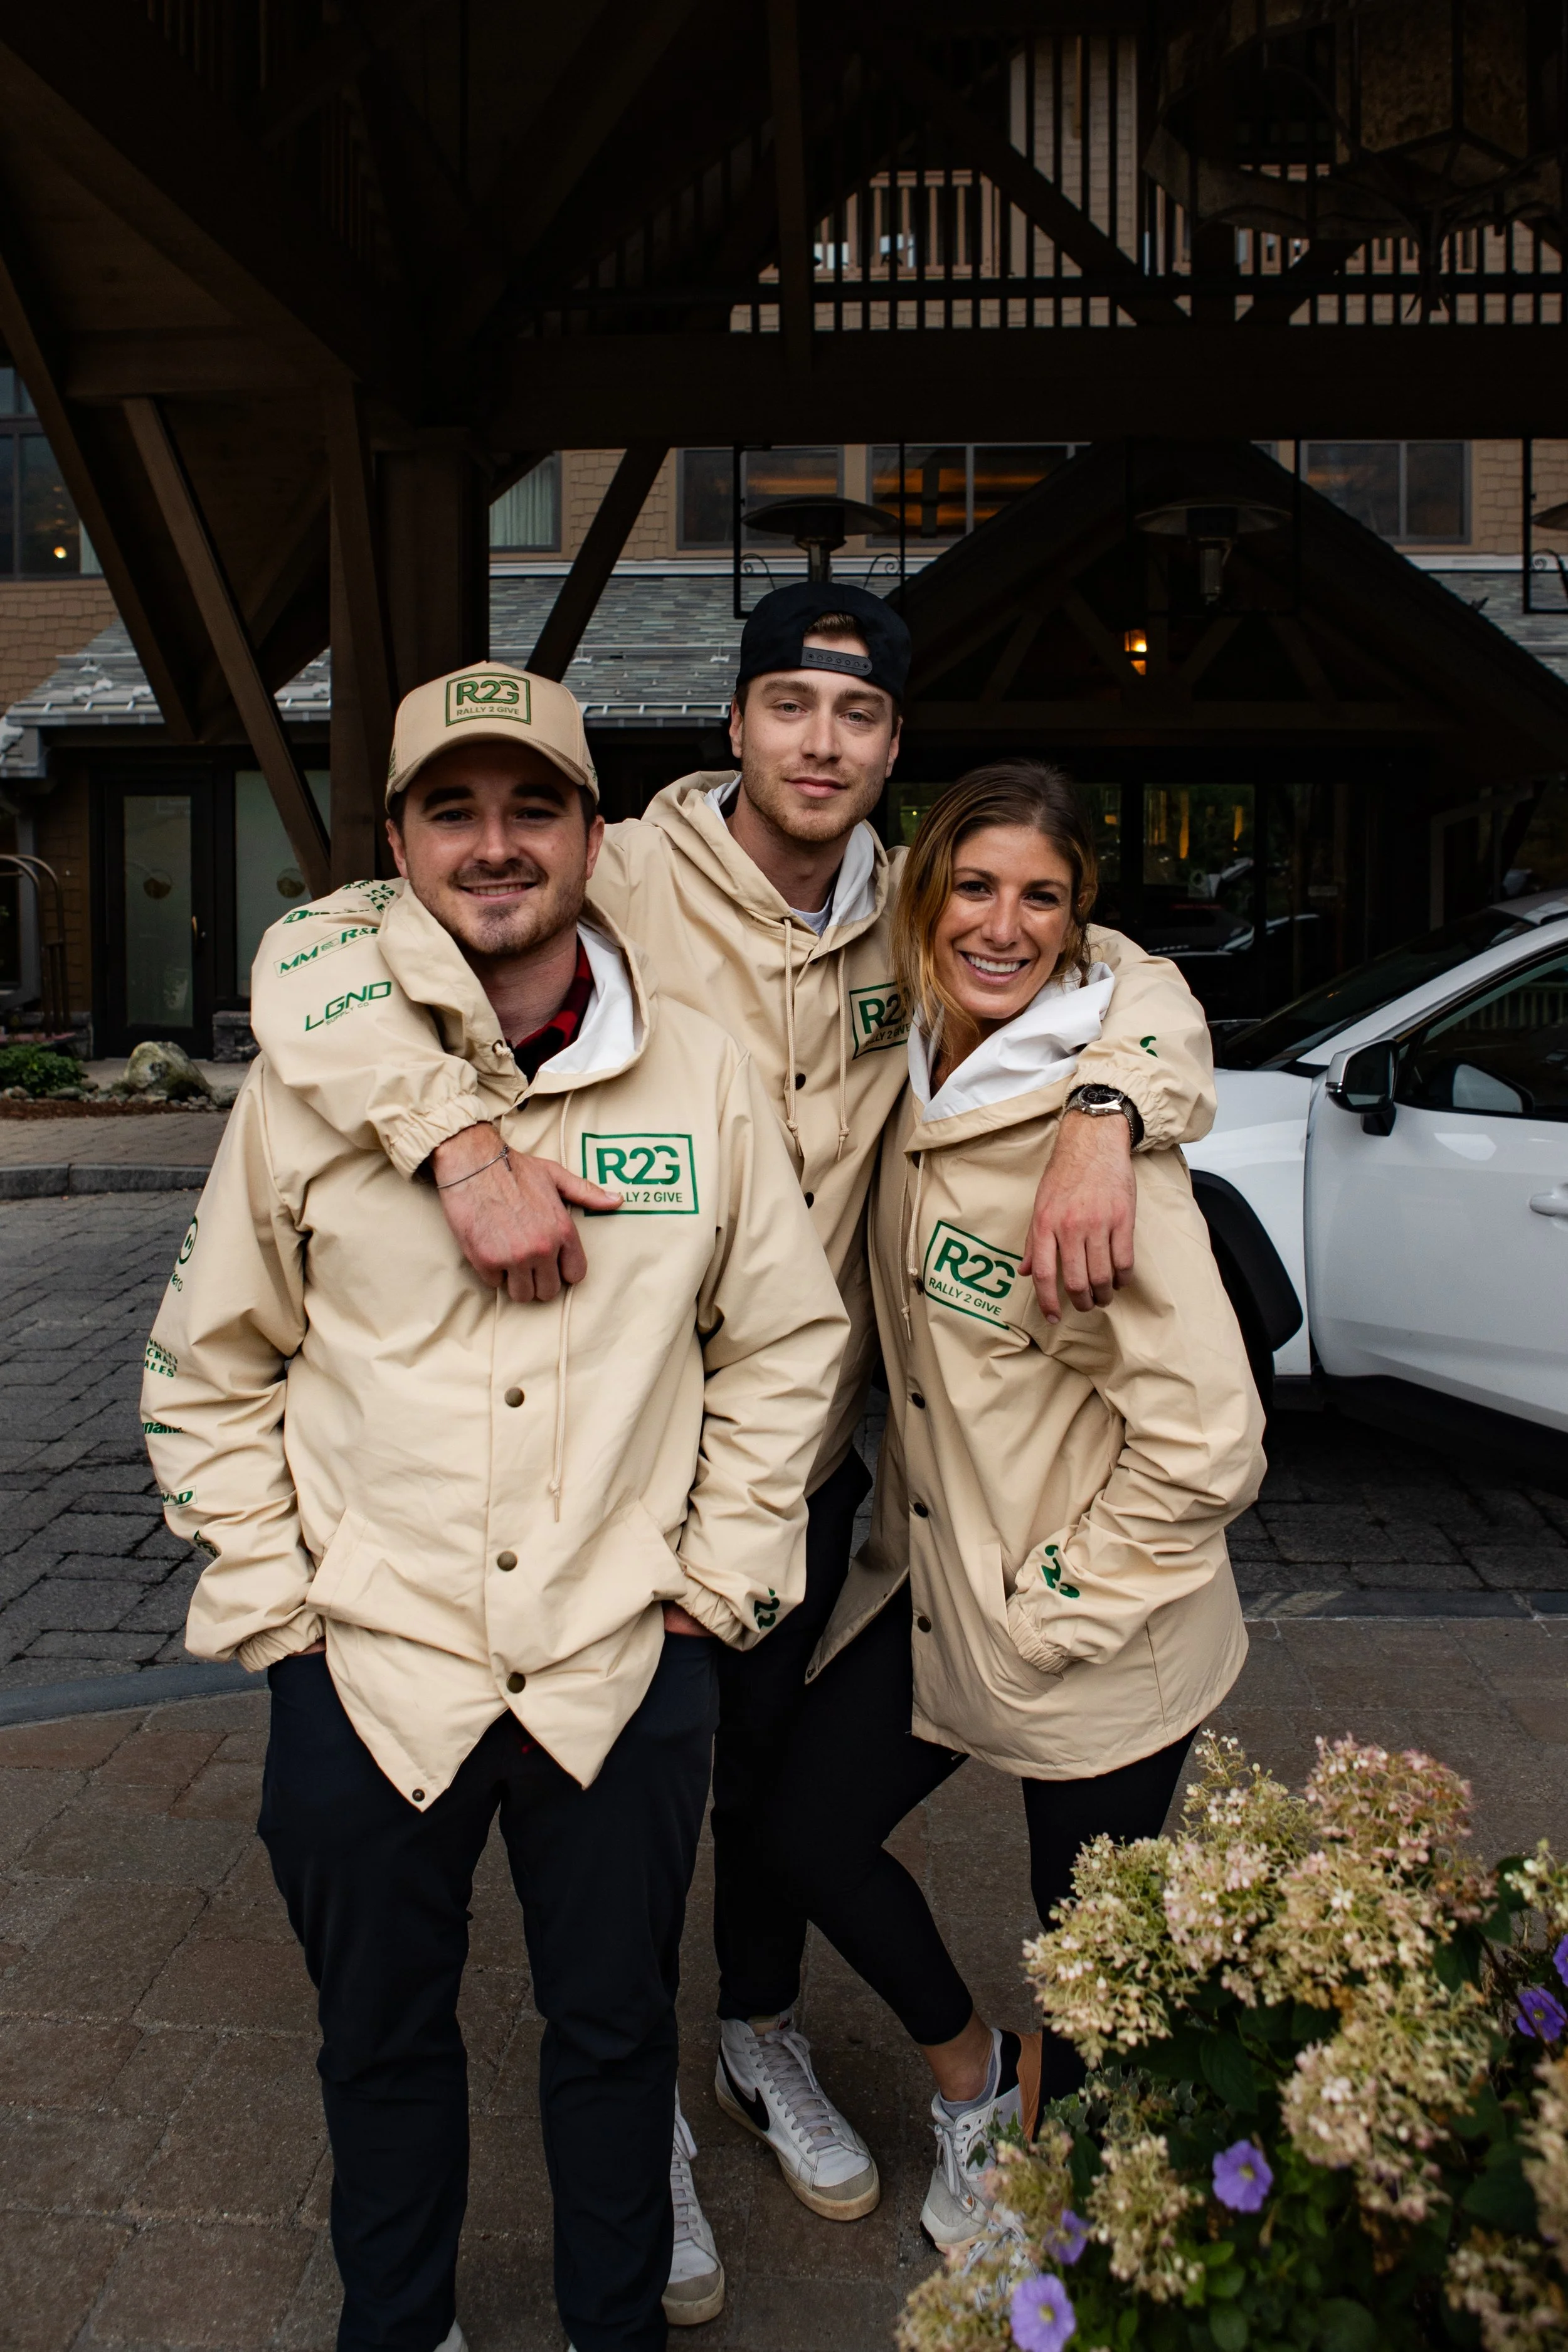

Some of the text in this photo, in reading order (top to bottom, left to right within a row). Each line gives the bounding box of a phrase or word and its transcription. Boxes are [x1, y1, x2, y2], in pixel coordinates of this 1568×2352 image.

[457, 680, 519, 706] R2G
[457, 706, 486, 716] RALLY
[497, 706, 519, 715] GIVE
[280, 945, 319, 973] MM
[305, 981, 391, 1032] LGND
[326, 1006, 354, 1025] SUPPLY
[596, 1145, 681, 1185] R2G
[643, 1192, 650, 1202] 2
[654, 1192, 683, 1202] GIVE
[933, 1237, 1015, 1299] R2G
[929, 1277, 1002, 1316] RALLY 2 GIVE
